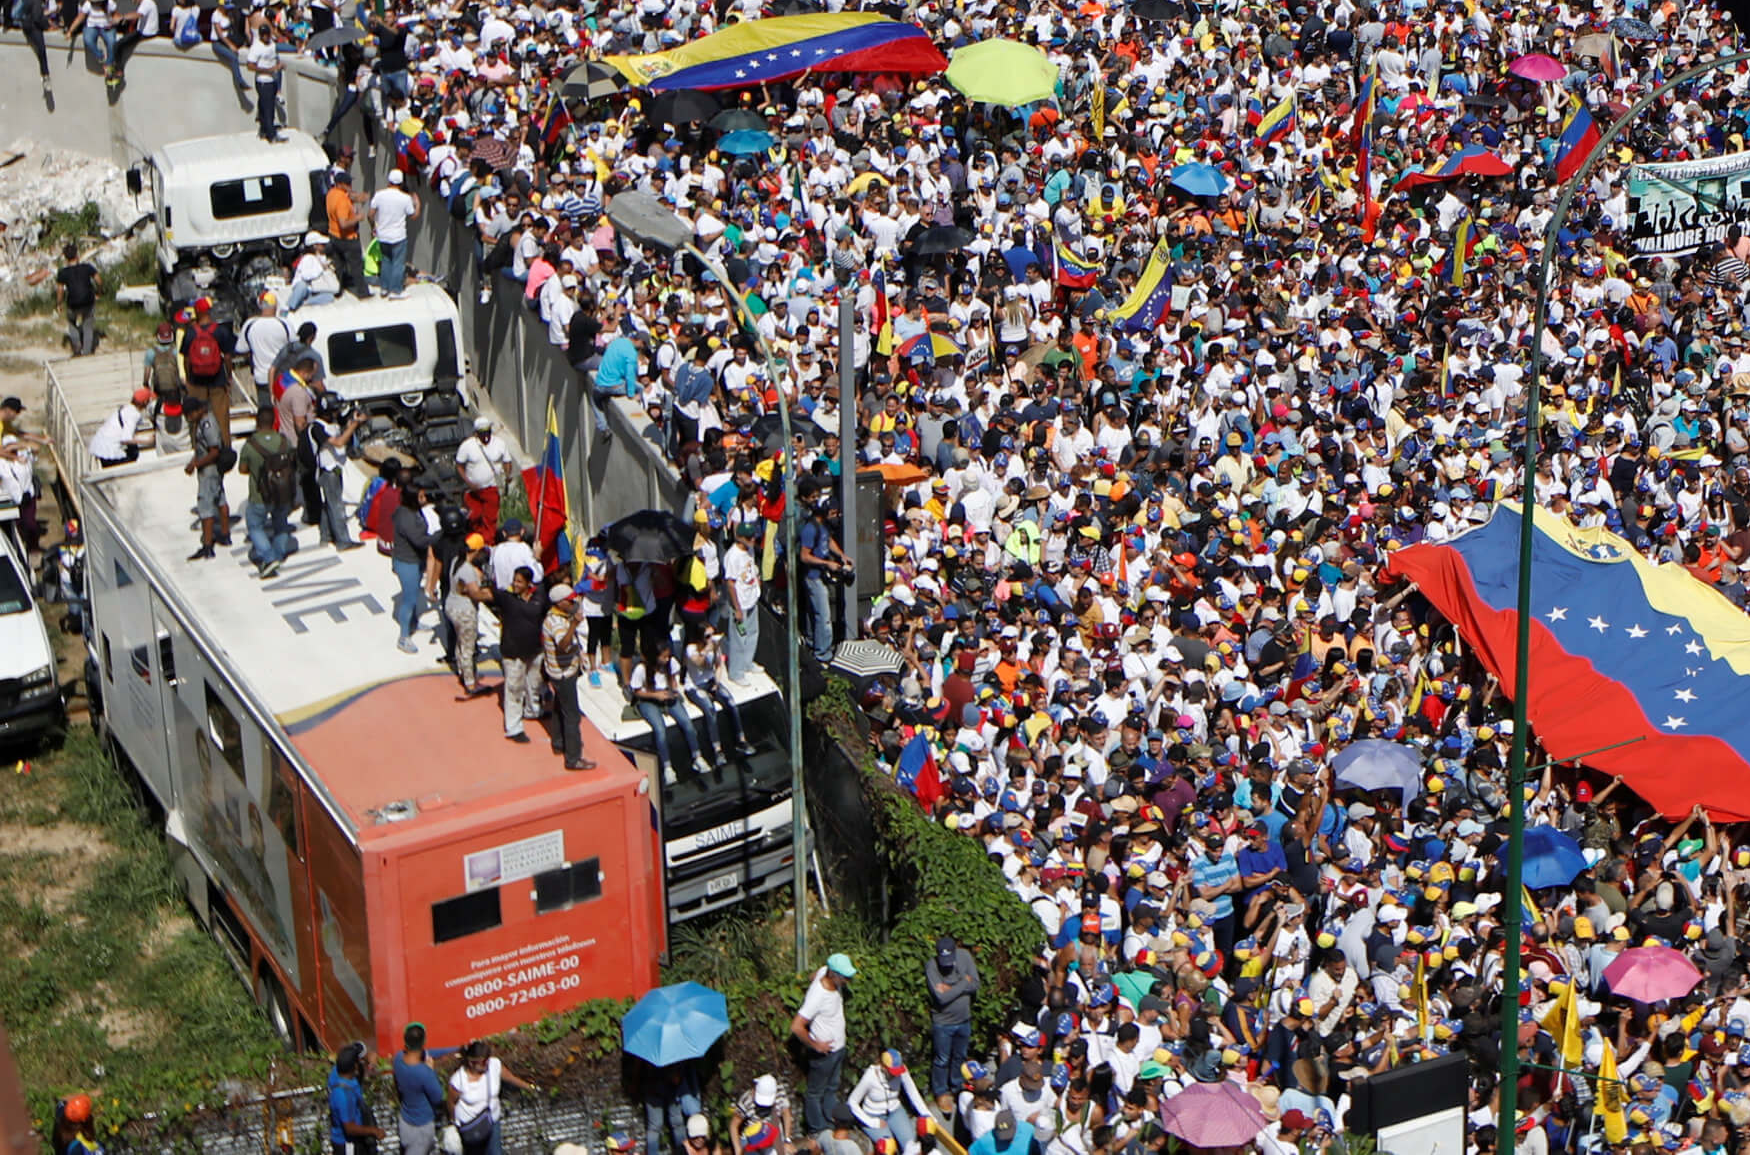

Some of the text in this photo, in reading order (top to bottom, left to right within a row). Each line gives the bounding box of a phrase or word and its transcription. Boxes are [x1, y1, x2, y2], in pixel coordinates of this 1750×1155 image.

[695, 819, 746, 848] SAIME
[470, 934, 570, 970] Para mayor información
[502, 960, 520, 971] con
[519, 949, 557, 966] nuestros
[464, 954, 580, 1000] 0800-SAIME-00
[465, 973, 581, 1019] 0800-72463-00
